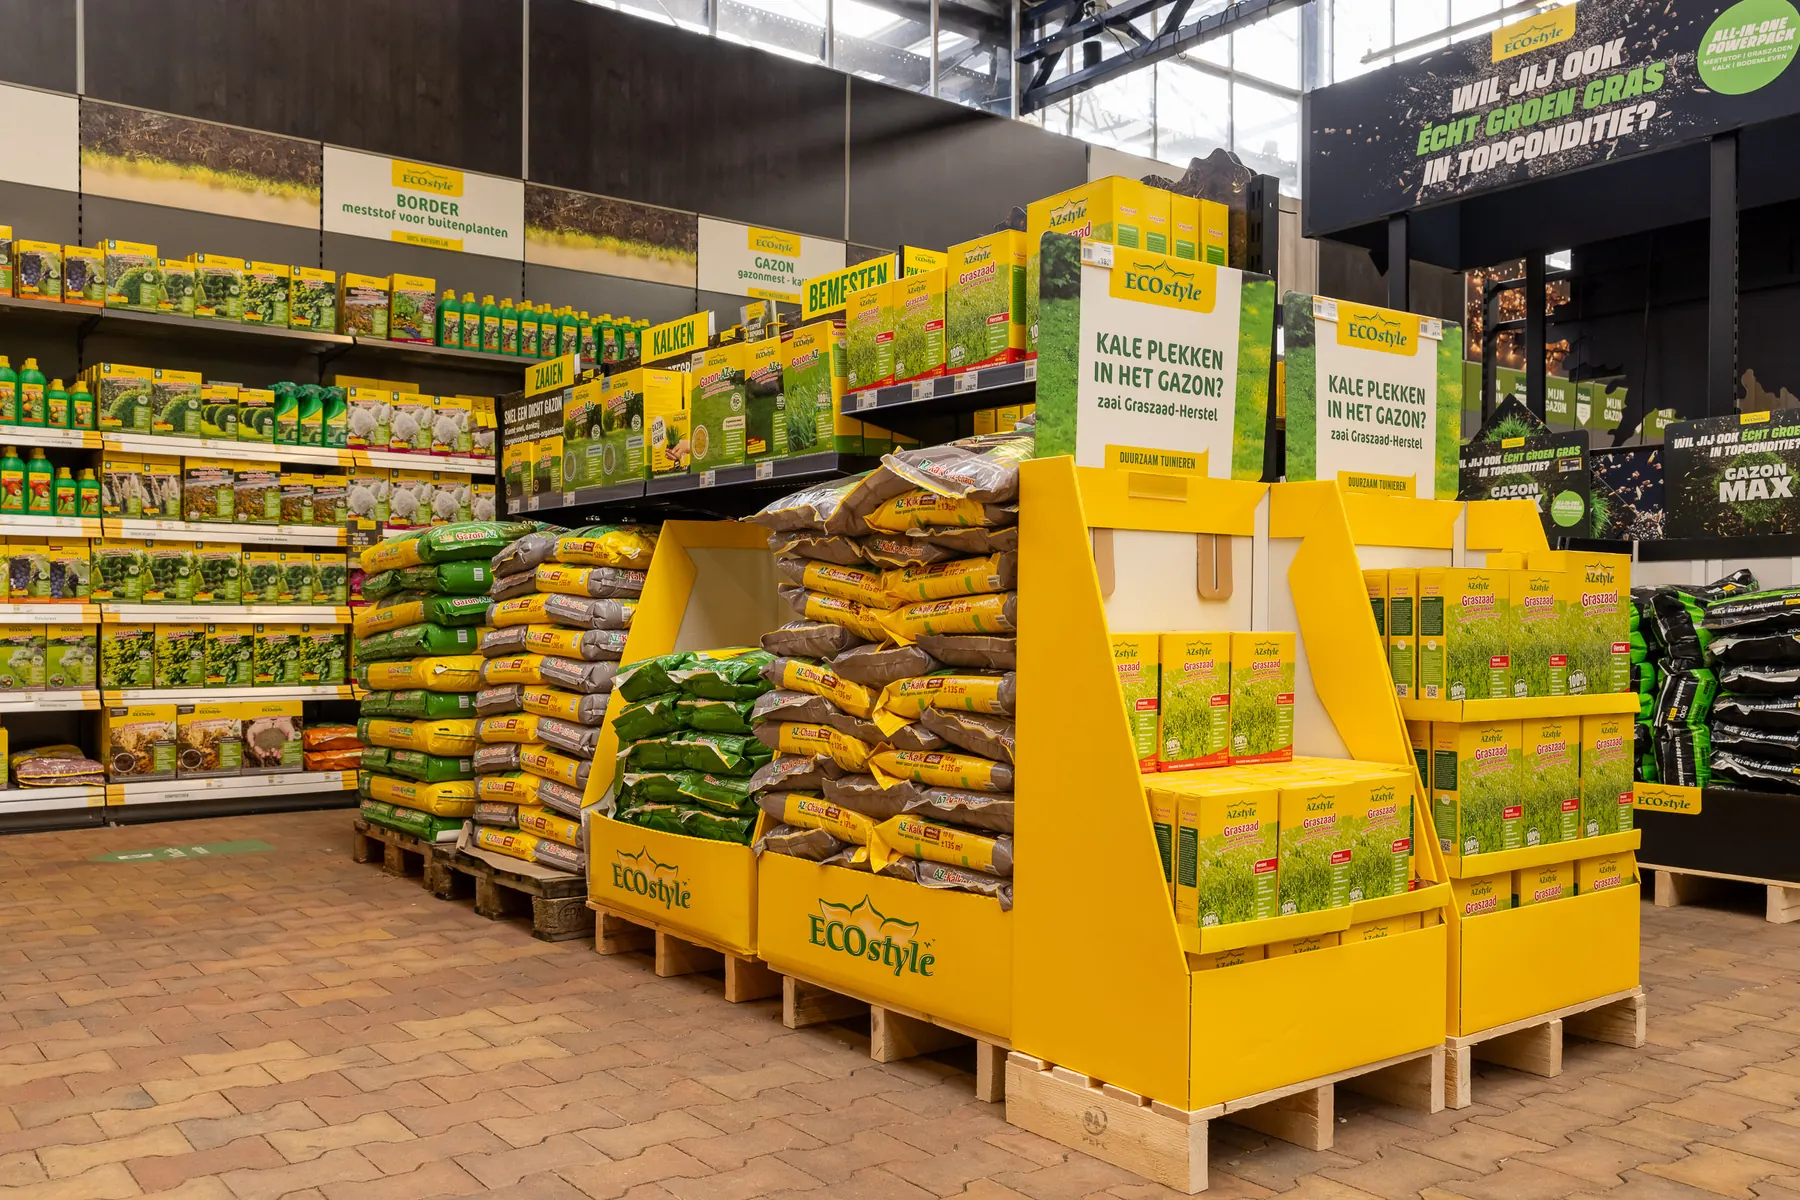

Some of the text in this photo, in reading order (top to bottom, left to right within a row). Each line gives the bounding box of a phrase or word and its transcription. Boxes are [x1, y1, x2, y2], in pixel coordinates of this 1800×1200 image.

[1712, 16, 1788, 42] ALL-IN-ONE
[1504, 26, 1563, 54] ECOstyle
[1706, 28, 1796, 56] POWERPACK
[1703, 44, 1793, 66] MESTSTOF GRASZADEN
[1712, 54, 1787, 72] KALK BODEMLEVEN
[1451, 37, 1626, 114] WIL JIJ OOK
[1416, 62, 1666, 156] ÉCHT GROEN GRAS
[1423, 101, 1656, 185] IN TOPCONDITIE?
[402, 174, 453, 191] ECOstyle
[397, 194, 459, 216] BORDER
[342, 203, 508, 238] meststof voor buitenplanten
[1049, 206, 1088, 228] AZstyle
[756, 239, 793, 252] ECOstyle
[755, 257, 794, 274] GAZON
[964, 250, 991, 265] AZstyle
[738, 270, 785, 284] gazonmest
[960, 260, 995, 284] Graszaad
[810, 262, 887, 312] BEMESTEN
[1124, 271, 1202, 302] ECOstyle
[906, 294, 929, 308] Graszaad
[654, 320, 695, 356] KALKEN
[1348, 322, 1407, 347] ECOstyle
[792, 349, 819, 368] Gazon-AZ
[1096, 332, 1224, 370] KALE PLEKKEN
[536, 362, 564, 390] ZAAIEN
[1094, 361, 1224, 398] IN HET GAZON?
[1328, 374, 1426, 406] KALE PLEKKEN
[1548, 388, 1564, 400] MIJN
[1577, 392, 1590, 402] Pokon
[504, 396, 563, 425] SNEL EEN DICHT GAZON
[1098, 396, 1218, 422] zaai Graszaad-Herstel
[1546, 402, 1566, 414] GAZON
[1606, 398, 1622, 410] MIJN
[1328, 400, 1427, 430] IN HET GAZON?
[1331, 429, 1422, 450] zaai Graszaad-Herstel
[1674, 425, 1800, 449] WIL JIJ OOK ÉCHT GROE
[1710, 438, 1800, 458] IN TOPCONDITIE?
[1120, 452, 1196, 470] DUURZAAM TUINIEREN
[1468, 457, 1483, 468] JIJ
[1484, 455, 1502, 466] OOK
[1503, 452, 1524, 464] ÉCHT
[1526, 448, 1556, 460] GROEN
[1556, 446, 1581, 457] GRAS
[1479, 466, 1490, 478] IN
[1490, 461, 1550, 477] TOPCONDITIE?
[1725, 463, 1786, 480] GAZON
[1348, 476, 1406, 492] DUURZAAM TUINIEREN
[1490, 482, 1538, 498] GAZON
[1720, 476, 1794, 502] MAX
[456, 530, 498, 540] Gazon-AZ
[1468, 582, 1490, 591] AZstyle
[1585, 572, 1615, 586] AZstyle
[1530, 584, 1550, 592] AZstyle
[1462, 592, 1494, 607] Graszaad
[1524, 594, 1554, 608] Graszaad
[1582, 590, 1618, 608] Graszaad
[1186, 648, 1212, 656] AZstyle
[1254, 648, 1279, 656] AZstyle
[1184, 658, 1214, 672] Graszaad
[1252, 659, 1280, 671] Graszaad
[944, 686, 958, 694] ±135
[1480, 734, 1503, 743] AZstyle
[1542, 730, 1562, 739] AZstyle
[1601, 726, 1619, 735] AZstyle
[1536, 740, 1566, 756] Graszaad
[1596, 736, 1623, 750] Graszaad
[1475, 744, 1508, 762] Graszaad
[1370, 792, 1395, 803] AZstyle
[1638, 794, 1690, 810] ECOstyle
[798, 800, 825, 815] AZ-Chaux
[1226, 807, 1257, 820] AZstyle
[1306, 801, 1334, 812] AZstyle
[1368, 804, 1397, 820] Graszaad
[898, 822, 922, 836] AZ-Kalk
[1224, 822, 1259, 838] Graszaad
[1303, 813, 1336, 830] Graszaad
[941, 840, 954, 850] ±135
[1599, 864, 1617, 874] AZstyle
[612, 862, 692, 910] ECOstyle
[1539, 874, 1557, 884] AZstyle
[1594, 874, 1620, 890] Graszaad
[1471, 886, 1492, 897] AZstyle
[1534, 884, 1562, 902] Graszaad
[1466, 895, 1497, 915] Graszaad
[808, 914, 936, 977] ECOstyle
